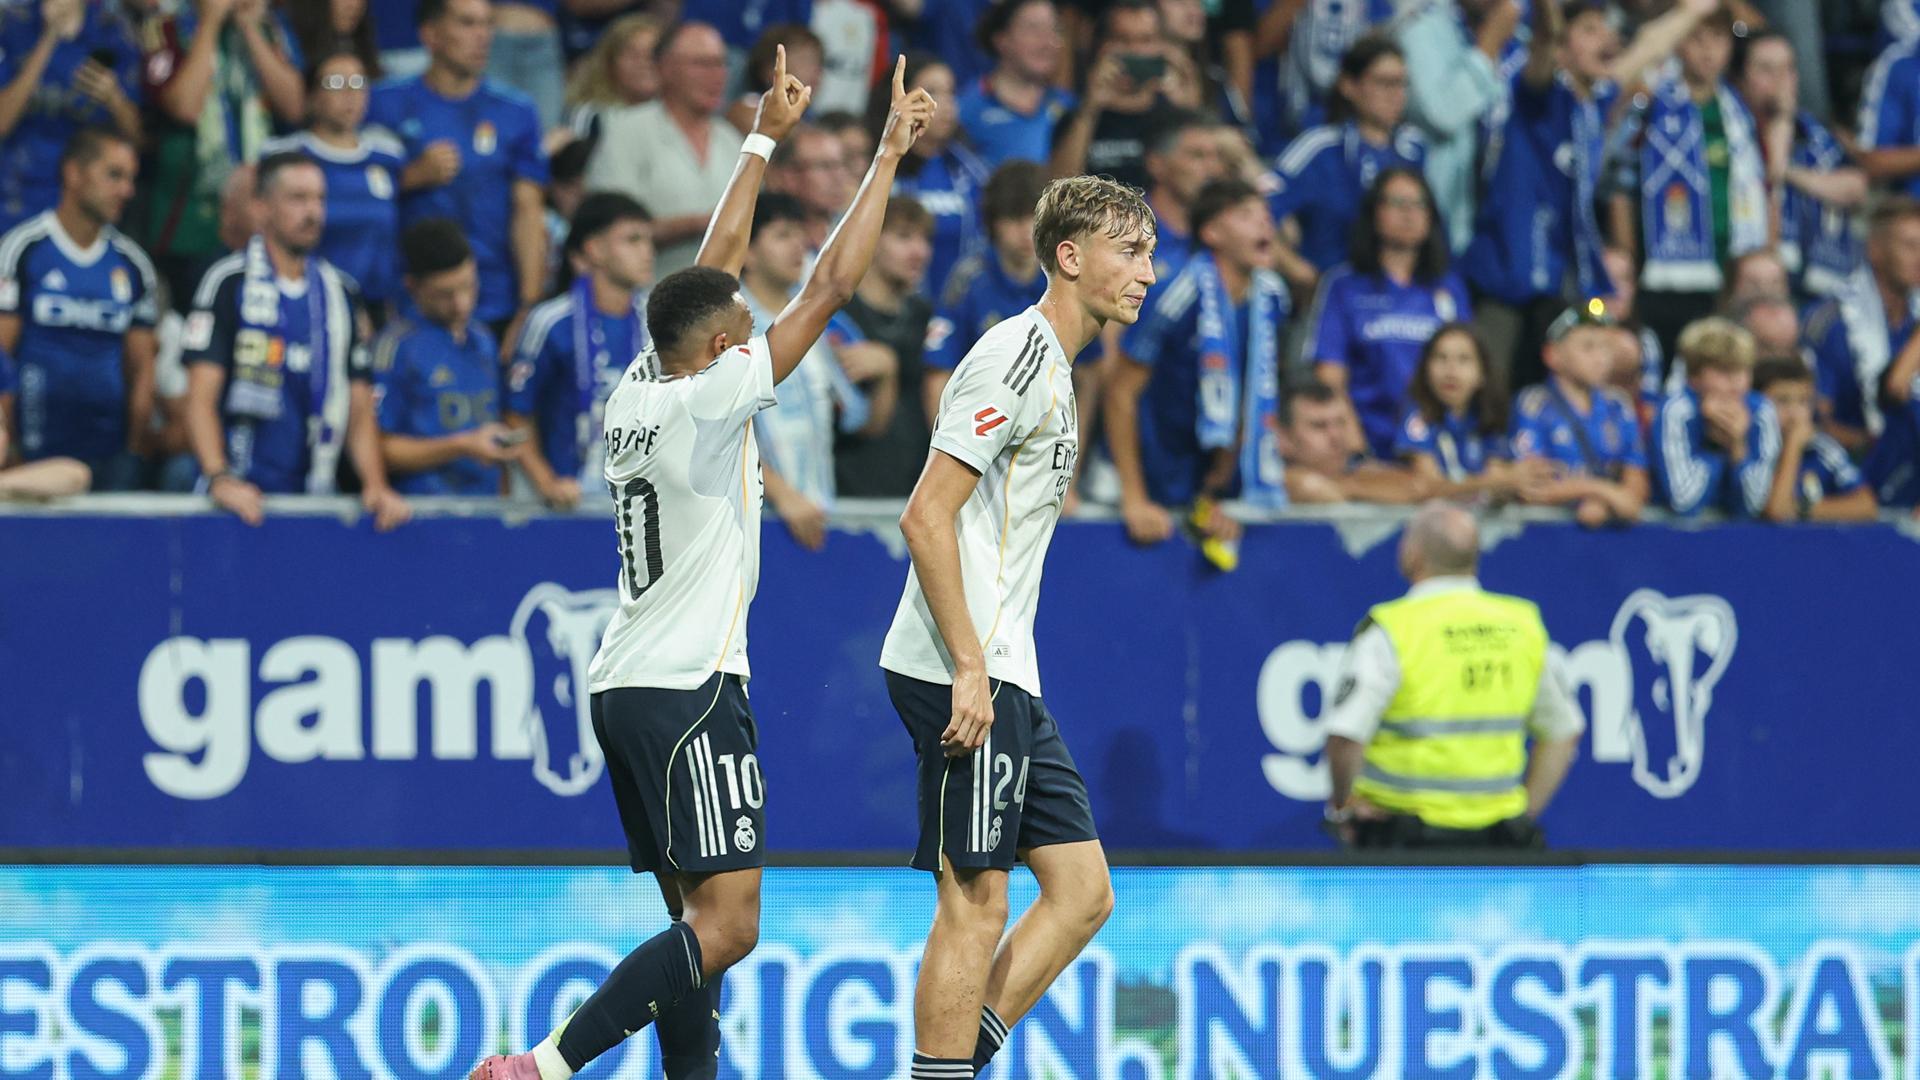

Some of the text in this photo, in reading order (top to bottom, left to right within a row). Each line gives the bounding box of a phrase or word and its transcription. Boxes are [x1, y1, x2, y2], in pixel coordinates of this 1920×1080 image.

[138, 635, 536, 800] gam
[717, 753, 764, 810] 10
[993, 752, 1031, 813] 24
[1190, 956, 1888, 1080] NUESTRA
